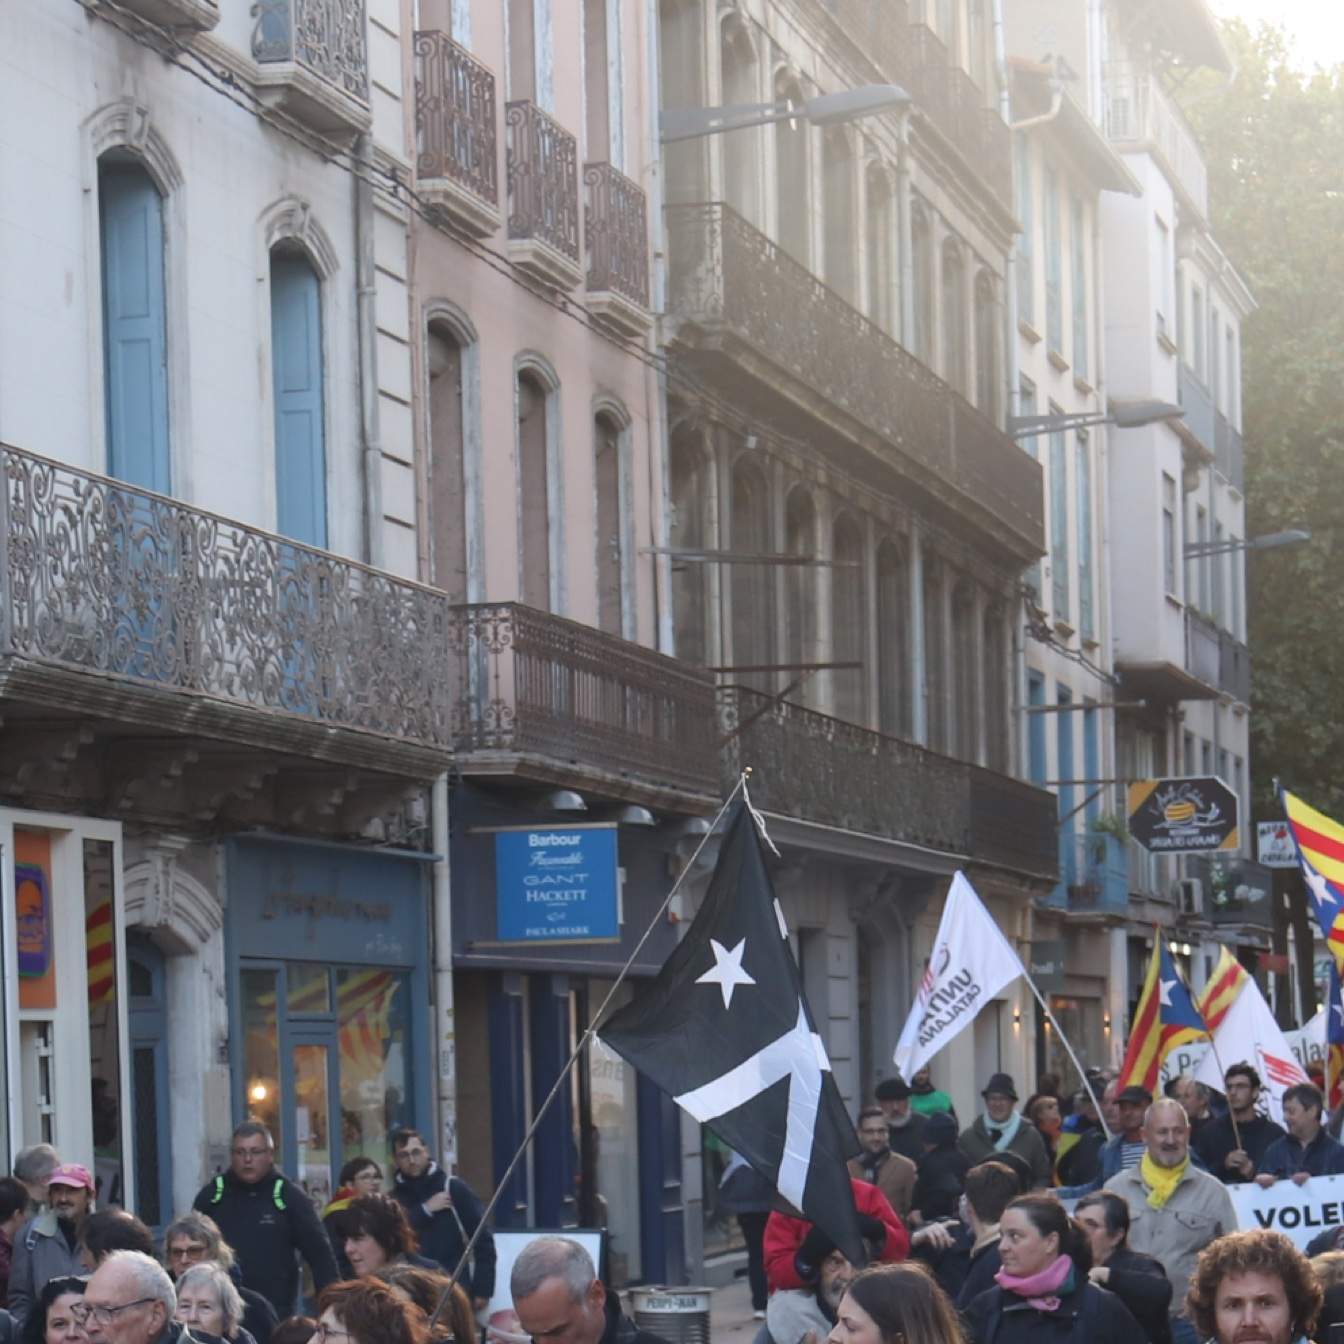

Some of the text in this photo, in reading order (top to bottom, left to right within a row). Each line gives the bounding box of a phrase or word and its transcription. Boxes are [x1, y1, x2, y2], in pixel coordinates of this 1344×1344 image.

[528, 833, 582, 848] Barbour
[523, 873, 589, 886] GANT
[525, 889, 587, 903] HACKETT
